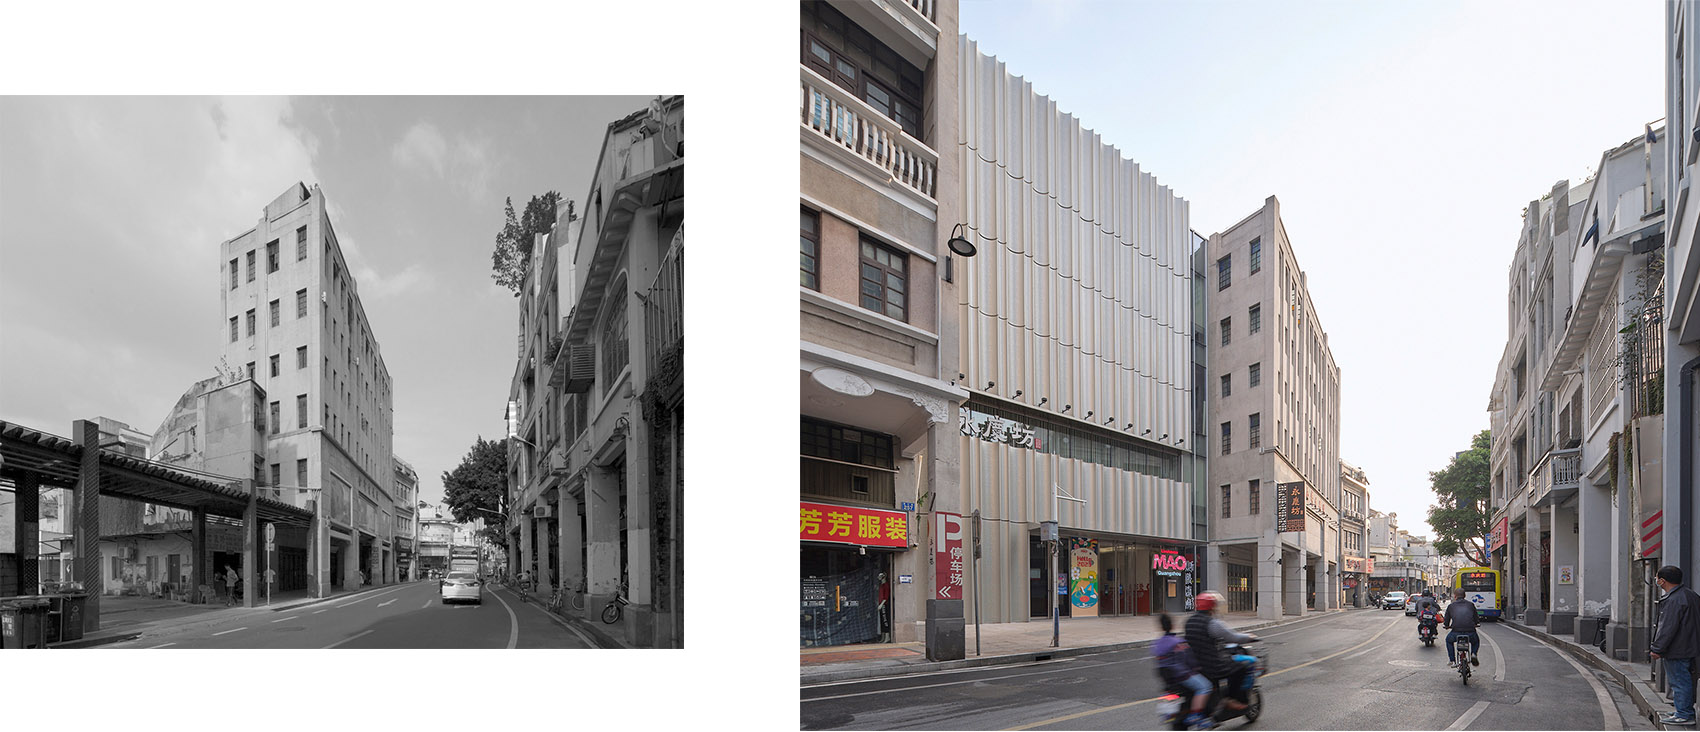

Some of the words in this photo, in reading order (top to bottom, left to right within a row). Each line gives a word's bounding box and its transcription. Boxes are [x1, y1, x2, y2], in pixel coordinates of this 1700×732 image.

[800, 508, 907, 540] 芳芳服装
[937, 513, 962, 552] P
[950, 547, 963, 586] 停车场
[1153, 554, 1187, 570] MAO
